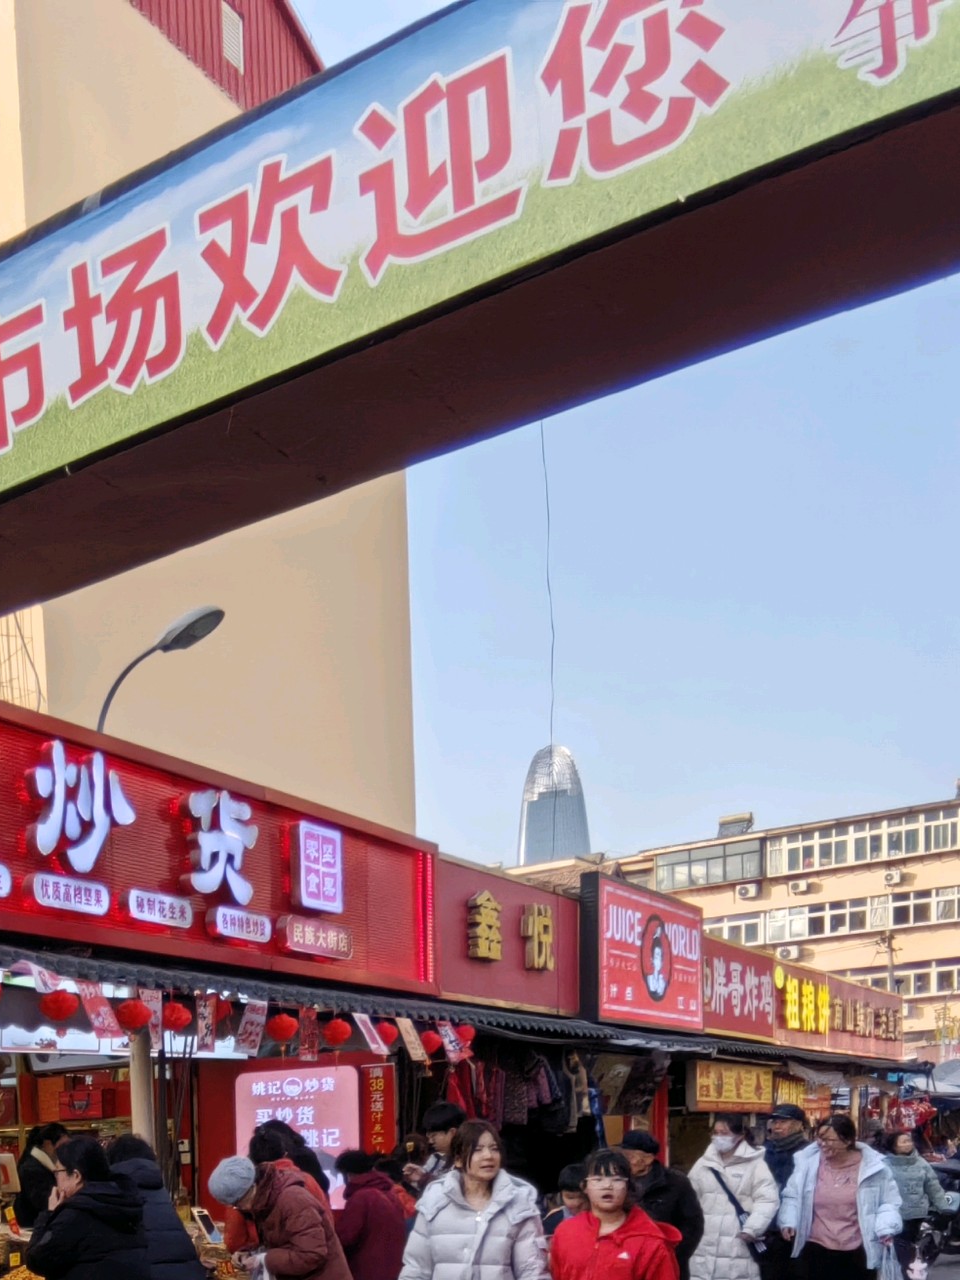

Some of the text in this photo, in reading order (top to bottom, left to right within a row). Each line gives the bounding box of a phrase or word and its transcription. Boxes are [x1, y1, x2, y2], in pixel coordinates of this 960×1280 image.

[41, 878, 103, 909] 优质高档坚果
[293, 923, 348, 952] 民族大街店
[467, 890, 555, 971] 鑫悦
[605, 904, 642, 947] JUICE
[711, 956, 773, 1025] 胖哥炸鸡
